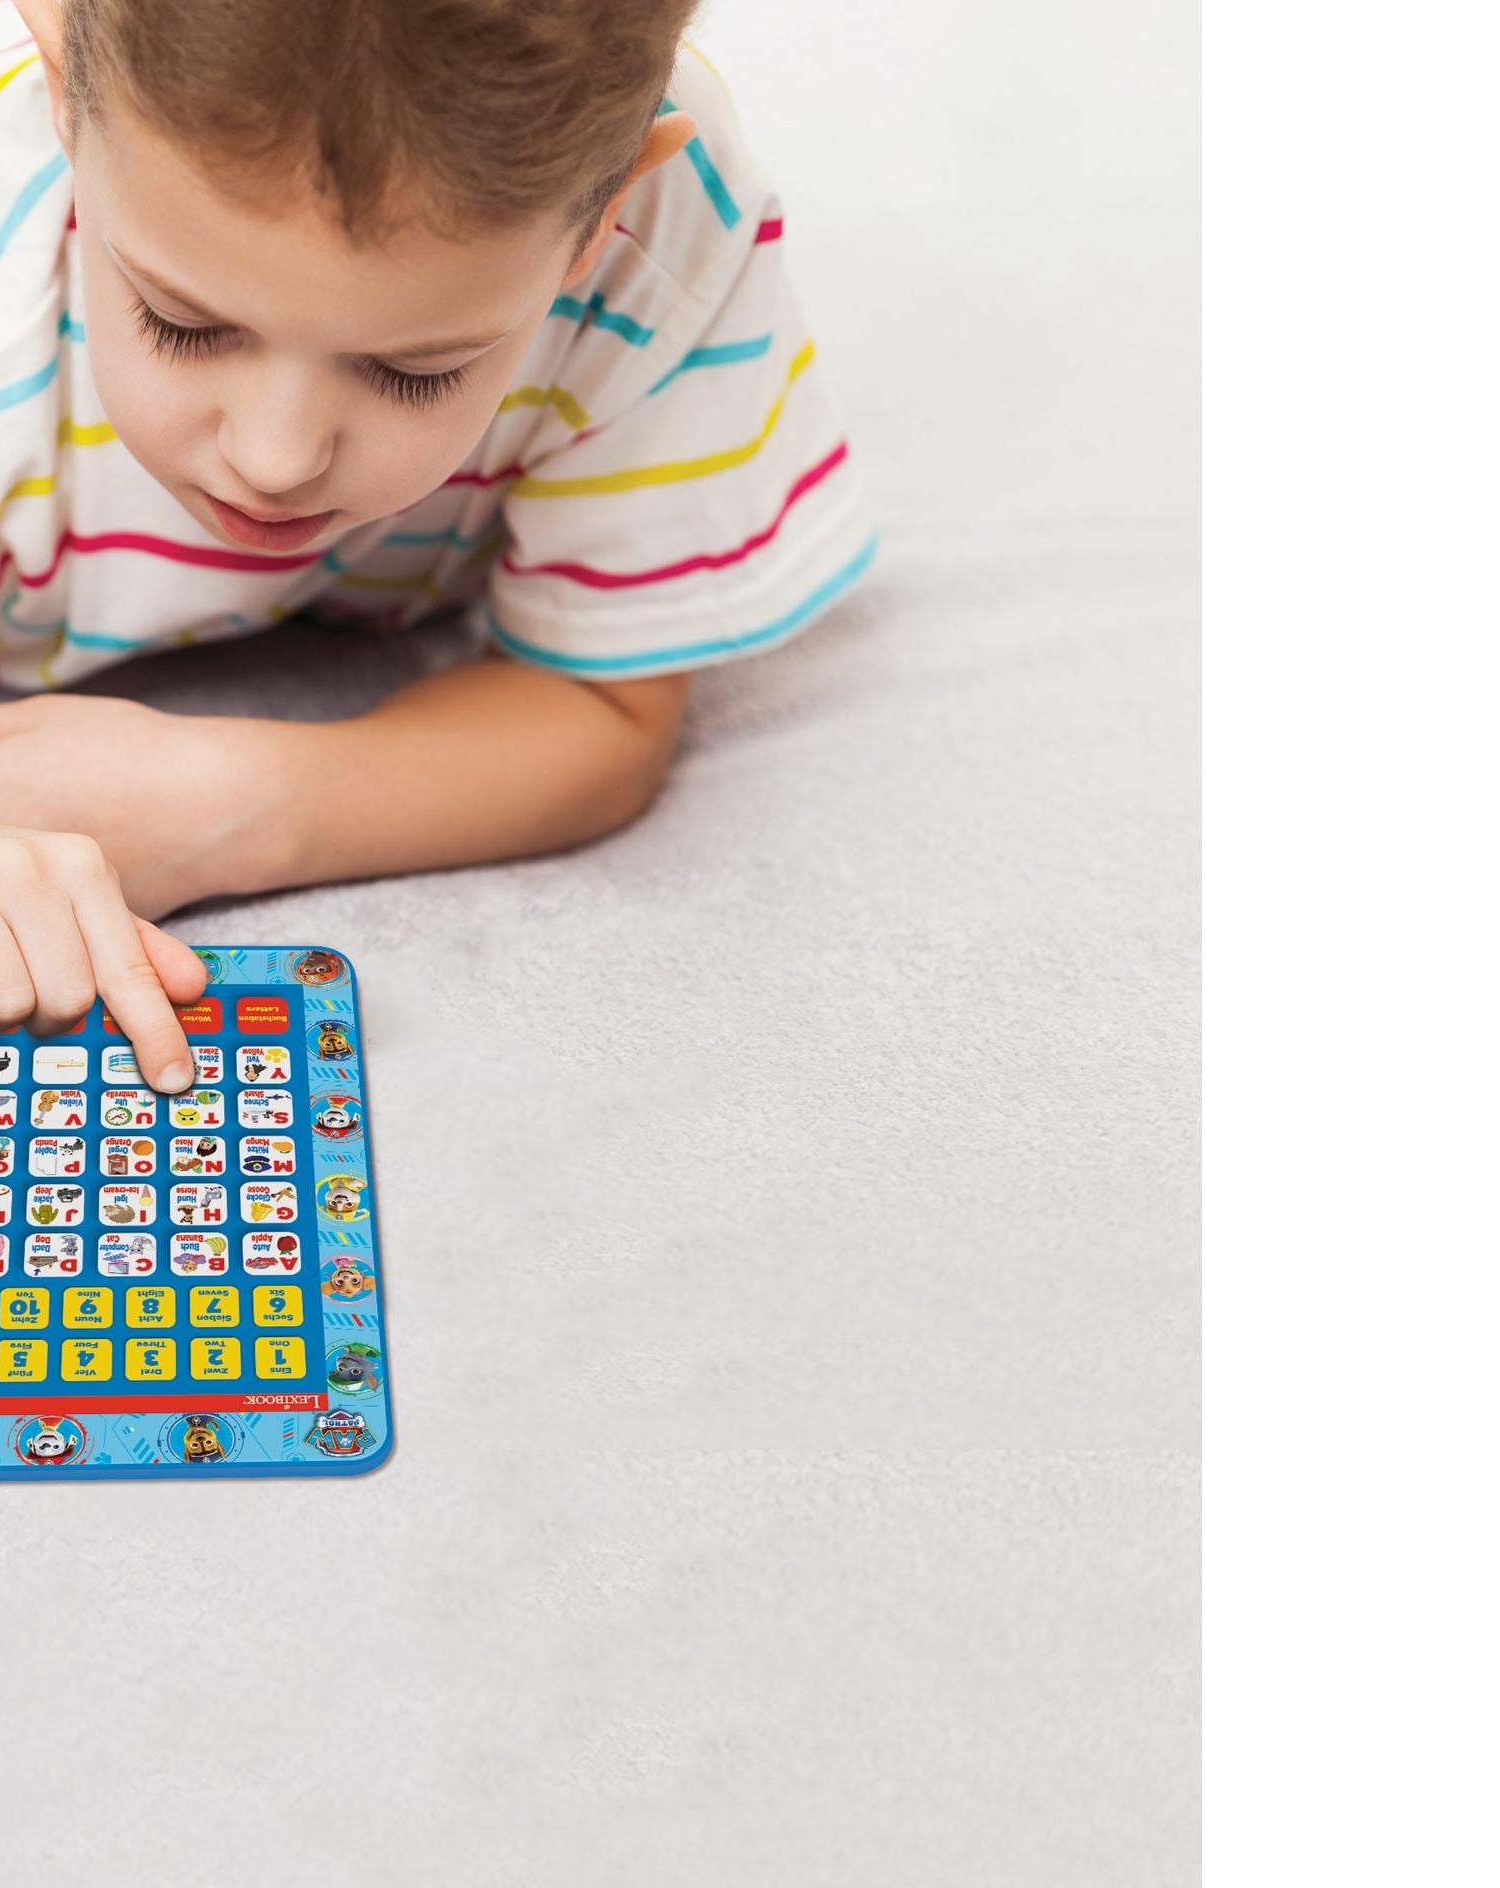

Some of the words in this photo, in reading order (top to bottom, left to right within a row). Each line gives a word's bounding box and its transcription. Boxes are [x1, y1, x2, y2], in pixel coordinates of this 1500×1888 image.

[242, 1048, 264, 1056] Yellow
[203, 1067, 219, 1078] Z
[270, 1068, 287, 1079] Y
[65, 1114, 82, 1126] V
[136, 1113, 152, 1124] U
[204, 1113, 219, 1124] T
[274, 1112, 288, 1124] S
[106, 1138, 132, 1146] Orange
[246, 1138, 270, 1146] Mango
[34, 1147, 57, 1155] Papier
[109, 1146, 128, 1154] Orgel
[175, 1146, 193, 1154] Nuss
[247, 1146, 269, 1154] Mütze
[65, 1161, 80, 1173] P
[135, 1161, 152, 1173] O
[206, 1161, 222, 1172] N
[273, 1161, 293, 1172] M
[35, 1186, 52, 1195] Jeep
[247, 1186, 269, 1194] Goose
[114, 1195, 128, 1203] Igel
[65, 1209, 79, 1222] J
[140, 1210, 146, 1222] I
[204, 1209, 221, 1221] H
[277, 1207, 294, 1219] G
[35, 1235, 50, 1244] Dog
[251, 1234, 273, 1242] Apple
[32, 1245, 51, 1253] Dach
[181, 1243, 200, 1251] Buch
[60, 1259, 77, 1272] D
[136, 1258, 153, 1272] C
[208, 1258, 225, 1271] B
[280, 1257, 298, 1270] A
[9, 1300, 40, 1315] 10
[80, 1299, 97, 1314] 9
[142, 1299, 159, 1314] 8
[206, 1298, 222, 1313] 7
[269, 1298, 286, 1312] 6
[139, 1315, 163, 1323] Acht
[13, 1351, 28, 1367] 5
[77, 1351, 95, 1367] 4
[144, 1350, 159, 1366] 3
[208, 1349, 223, 1365] 2
[275, 1349, 286, 1365] 1
[243, 1395, 320, 1409] LEXIBOOK
[305, 1428, 377, 1449] PAW
